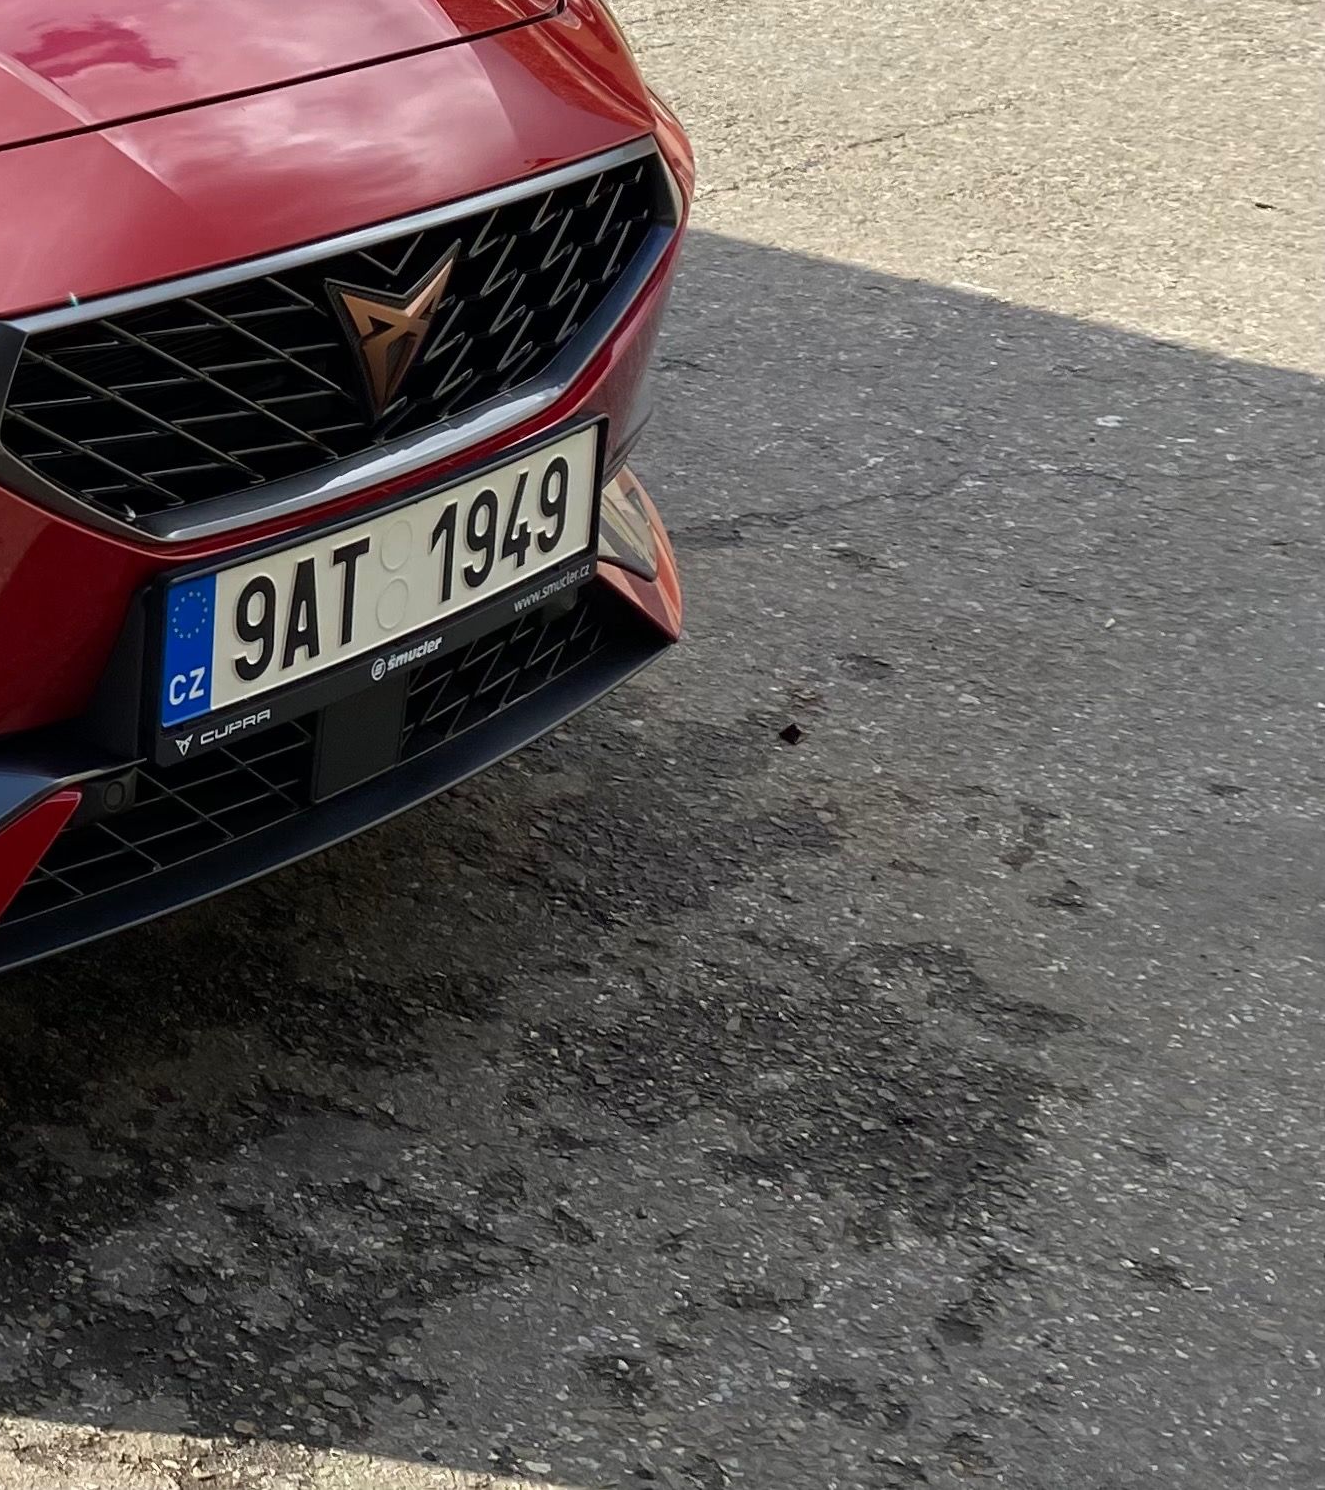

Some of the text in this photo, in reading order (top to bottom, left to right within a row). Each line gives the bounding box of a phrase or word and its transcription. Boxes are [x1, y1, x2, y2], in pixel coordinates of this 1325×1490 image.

[233, 456, 569, 682] 9AT 1949
[168, 666, 206, 706] CZ
[200, 708, 271, 745] CUPRA
